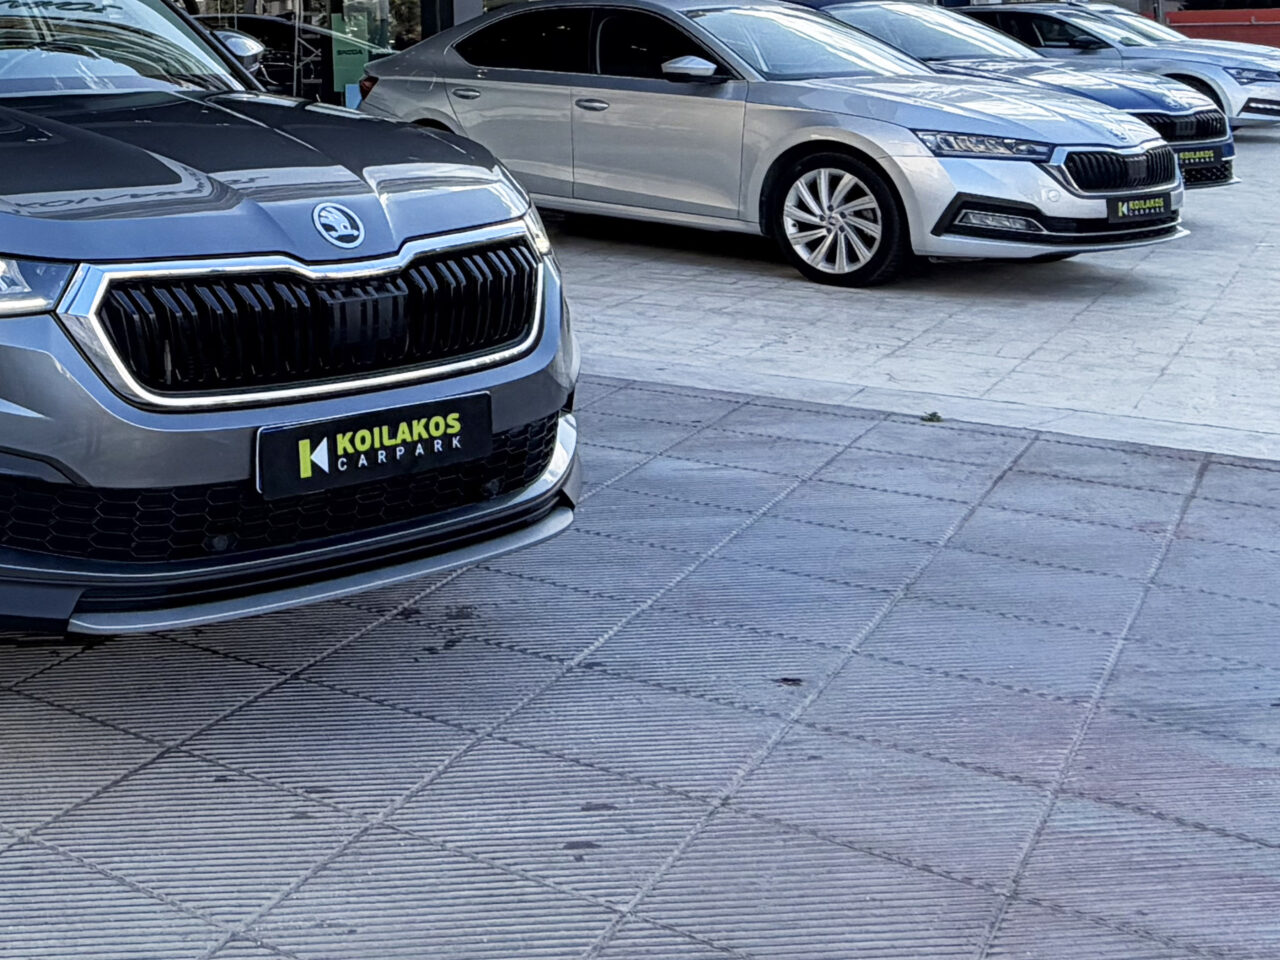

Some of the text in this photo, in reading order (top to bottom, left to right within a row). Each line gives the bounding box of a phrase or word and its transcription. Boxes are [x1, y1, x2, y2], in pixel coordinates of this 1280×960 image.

[1129, 197, 1164, 210] KOILAKOS
[336, 412, 462, 456] KOILAKOS
[337, 435, 462, 471] CARPARK
